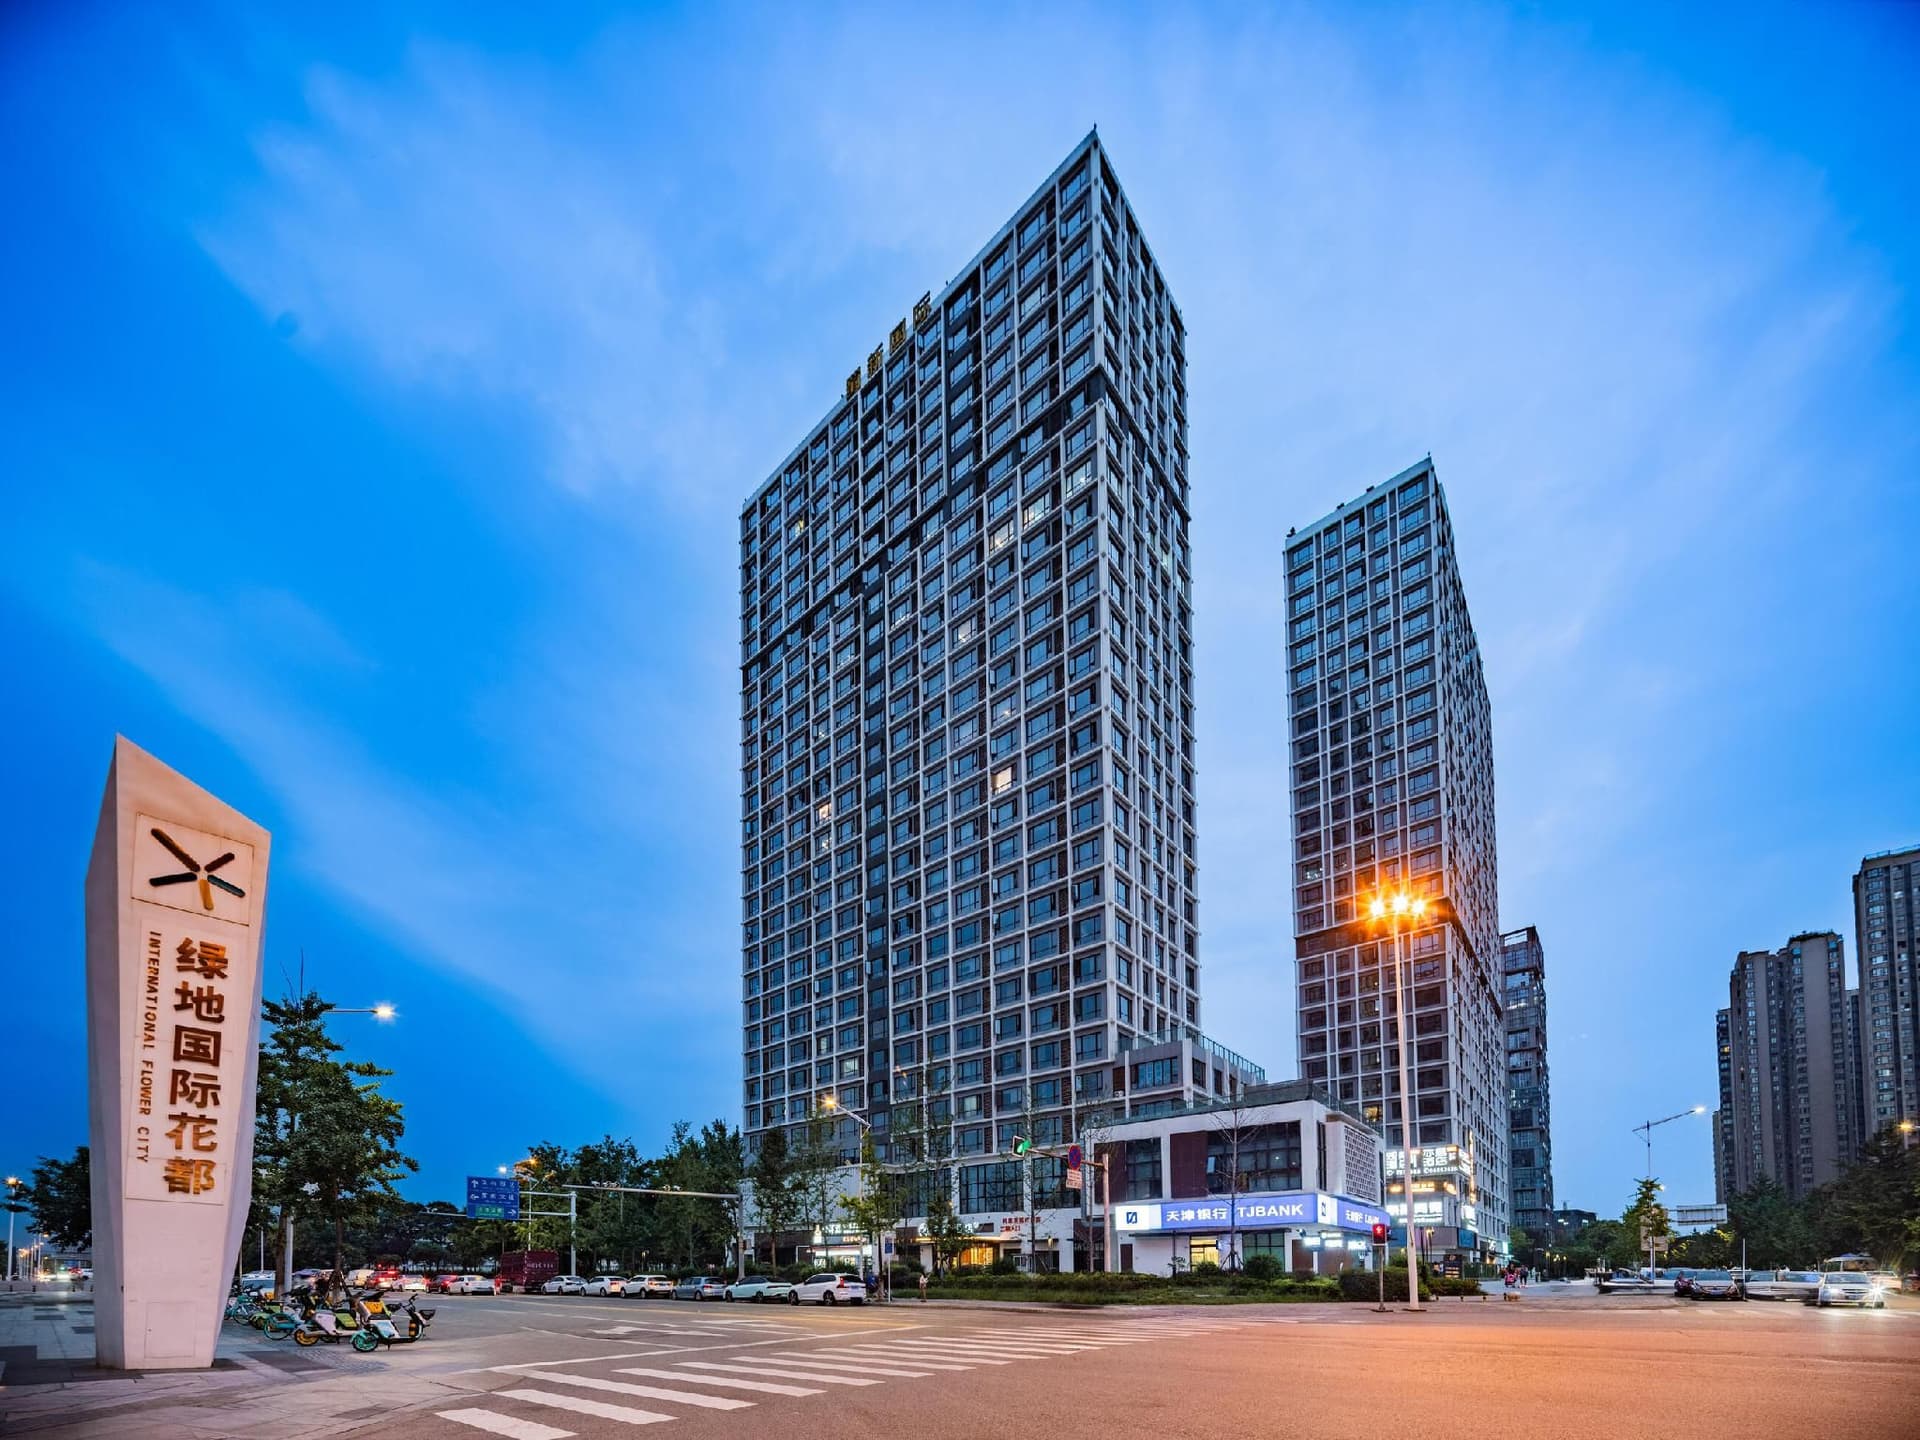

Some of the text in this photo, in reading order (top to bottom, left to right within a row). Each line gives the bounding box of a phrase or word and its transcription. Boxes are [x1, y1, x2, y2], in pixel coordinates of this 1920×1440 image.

[136, 931, 162, 1163] INTERNATIONAL FLOWER CITY
[163, 937, 229, 1195] 绿地国际花都
[1166, 1204, 1303, 1222] 天津银行 TJBANK
